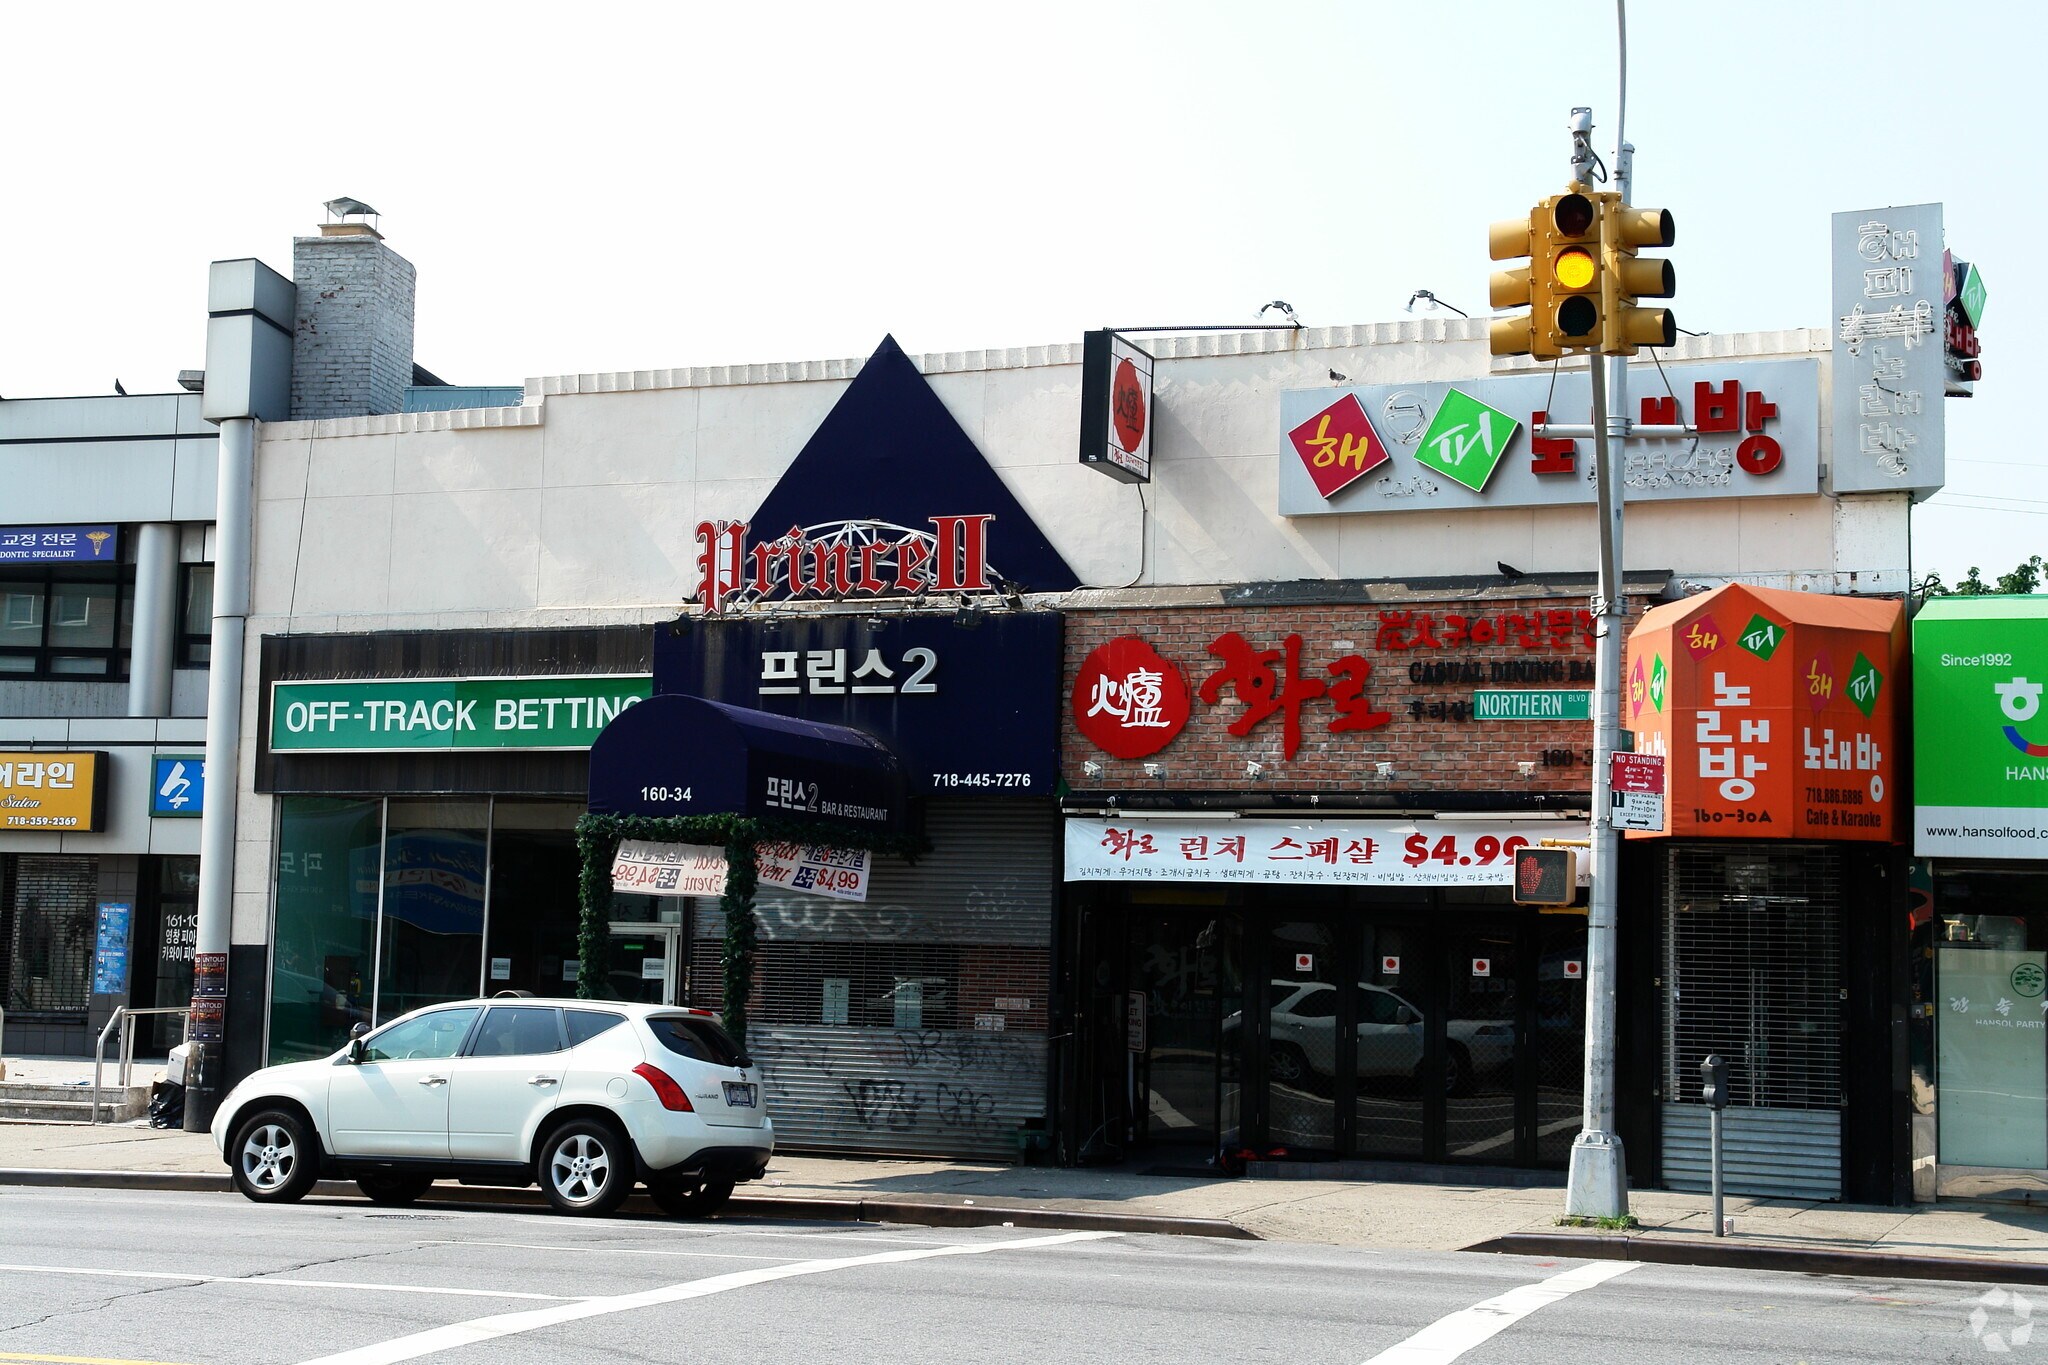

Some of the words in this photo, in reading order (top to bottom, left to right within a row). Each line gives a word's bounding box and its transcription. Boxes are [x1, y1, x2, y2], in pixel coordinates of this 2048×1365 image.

[1531, 379, 1783, 475] 노방
[1, 533, 37, 546] 교정
[41, 533, 77, 546] 전문
[32, 550, 76, 558] SPECIALIST
[758, 646, 939, 695] 프린스2
[1409, 660, 1485, 684] CASUAL
[1490, 660, 1563, 683] DINING
[1568, 660, 1596, 682] BA
[1479, 694, 1563, 716] NORTHERN
[1568, 694, 1586, 703] BLVD
[285, 699, 478, 733] OFF-TRACK
[1541, 749, 1594, 768] 160-3
[1616, 755, 1626, 763] NO
[1629, 756, 1662, 766] STANDING
[1803, 727, 1884, 803] 노래방
[933, 772, 1031, 788] 718-445-7276
[1, 794, 41, 808] Salon
[640, 786, 692, 802] 160-34
[1805, 787, 1863, 805] 718.886.6886
[821, 801, 836, 815] BAR
[843, 804, 889, 821] RESTAURANT
[1806, 808, 1829, 825] Cafe
[1831, 809, 1840, 825] &
[1841, 810, 1882, 828] Karaoke
[7, 816, 77, 826] 718-359-2369
[1179, 834, 1246, 863] 런치
[1267, 836, 1380, 865] 스페샬
[1402, 832, 1530, 868] $4.99
[816, 867, 860, 892] $4.99
[165, 929, 181, 945] 영창
[181, 929, 197, 945] 피아
[162, 946, 183, 962] 카와이
[2016, 1020, 2046, 1029] PARTY
